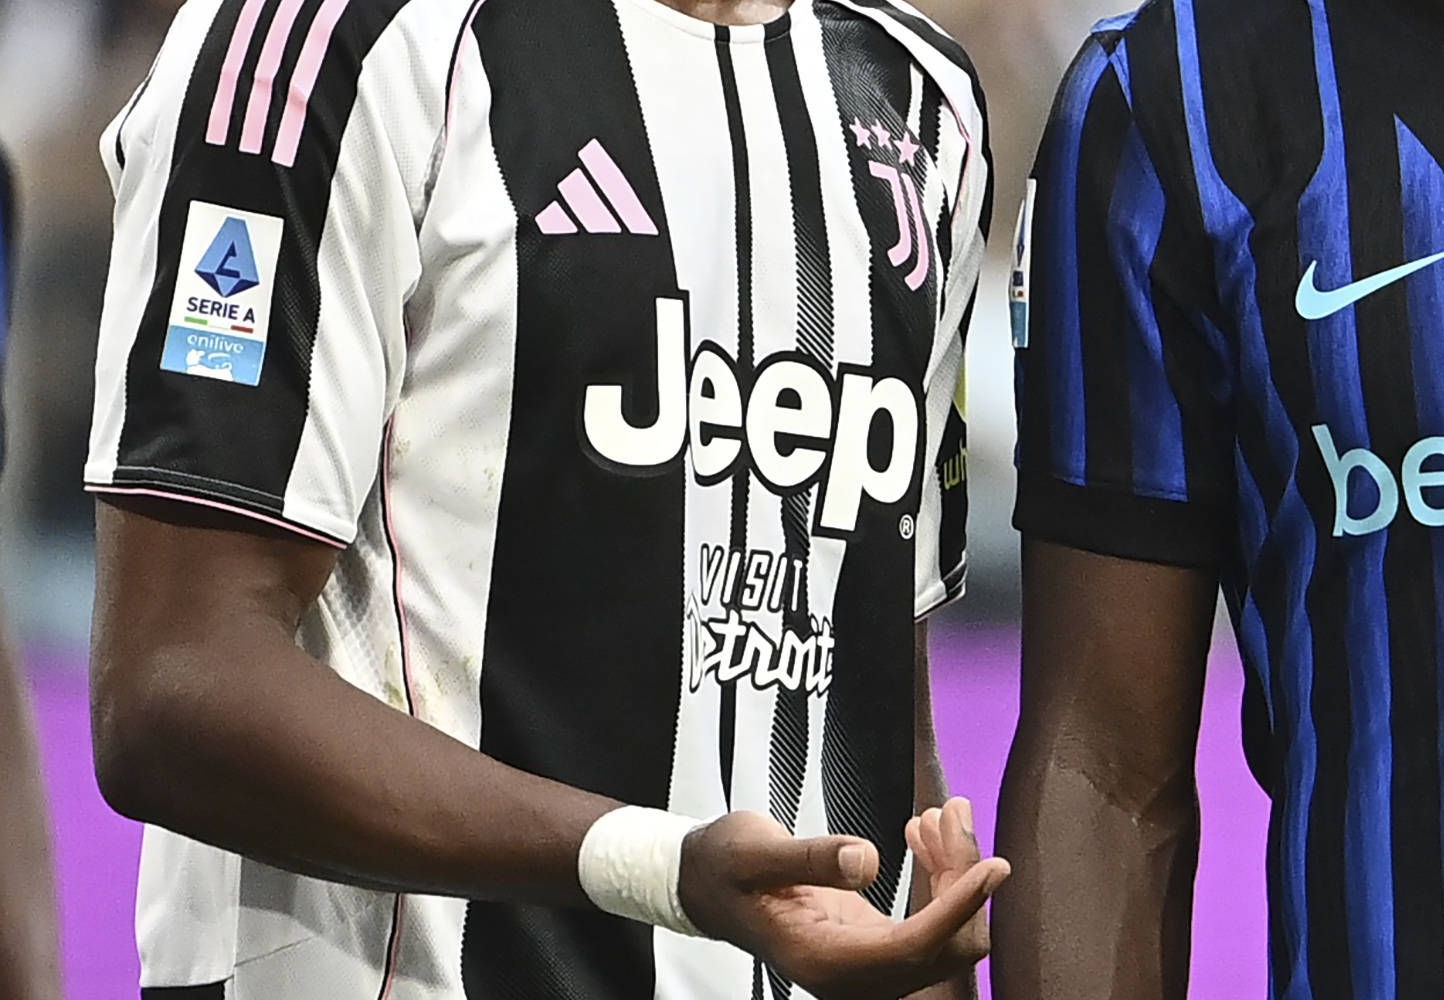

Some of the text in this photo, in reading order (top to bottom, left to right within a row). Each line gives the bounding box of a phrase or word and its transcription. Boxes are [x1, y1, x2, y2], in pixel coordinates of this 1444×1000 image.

[187, 297, 256, 323] SERIE A
[583, 296, 919, 532] Jeep
[701, 543, 805, 614] VISIT
[686, 592, 836, 695] Detroit
